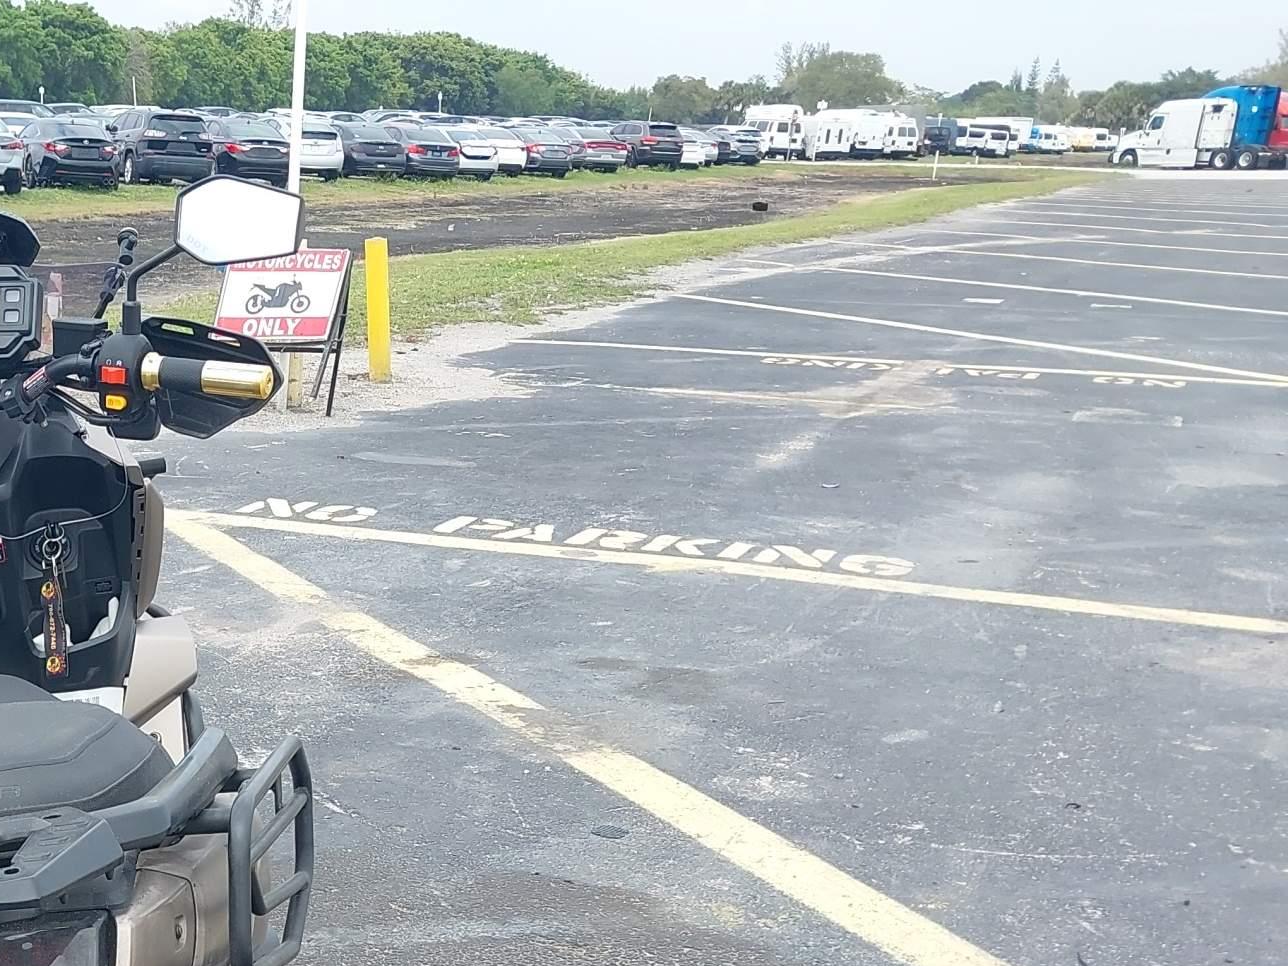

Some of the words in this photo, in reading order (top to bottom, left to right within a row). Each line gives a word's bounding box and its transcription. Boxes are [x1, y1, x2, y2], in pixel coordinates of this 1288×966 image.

[242, 318, 303, 337] ONLY
[235, 497, 379, 523] NO
[432, 515, 915, 577] PARKING
